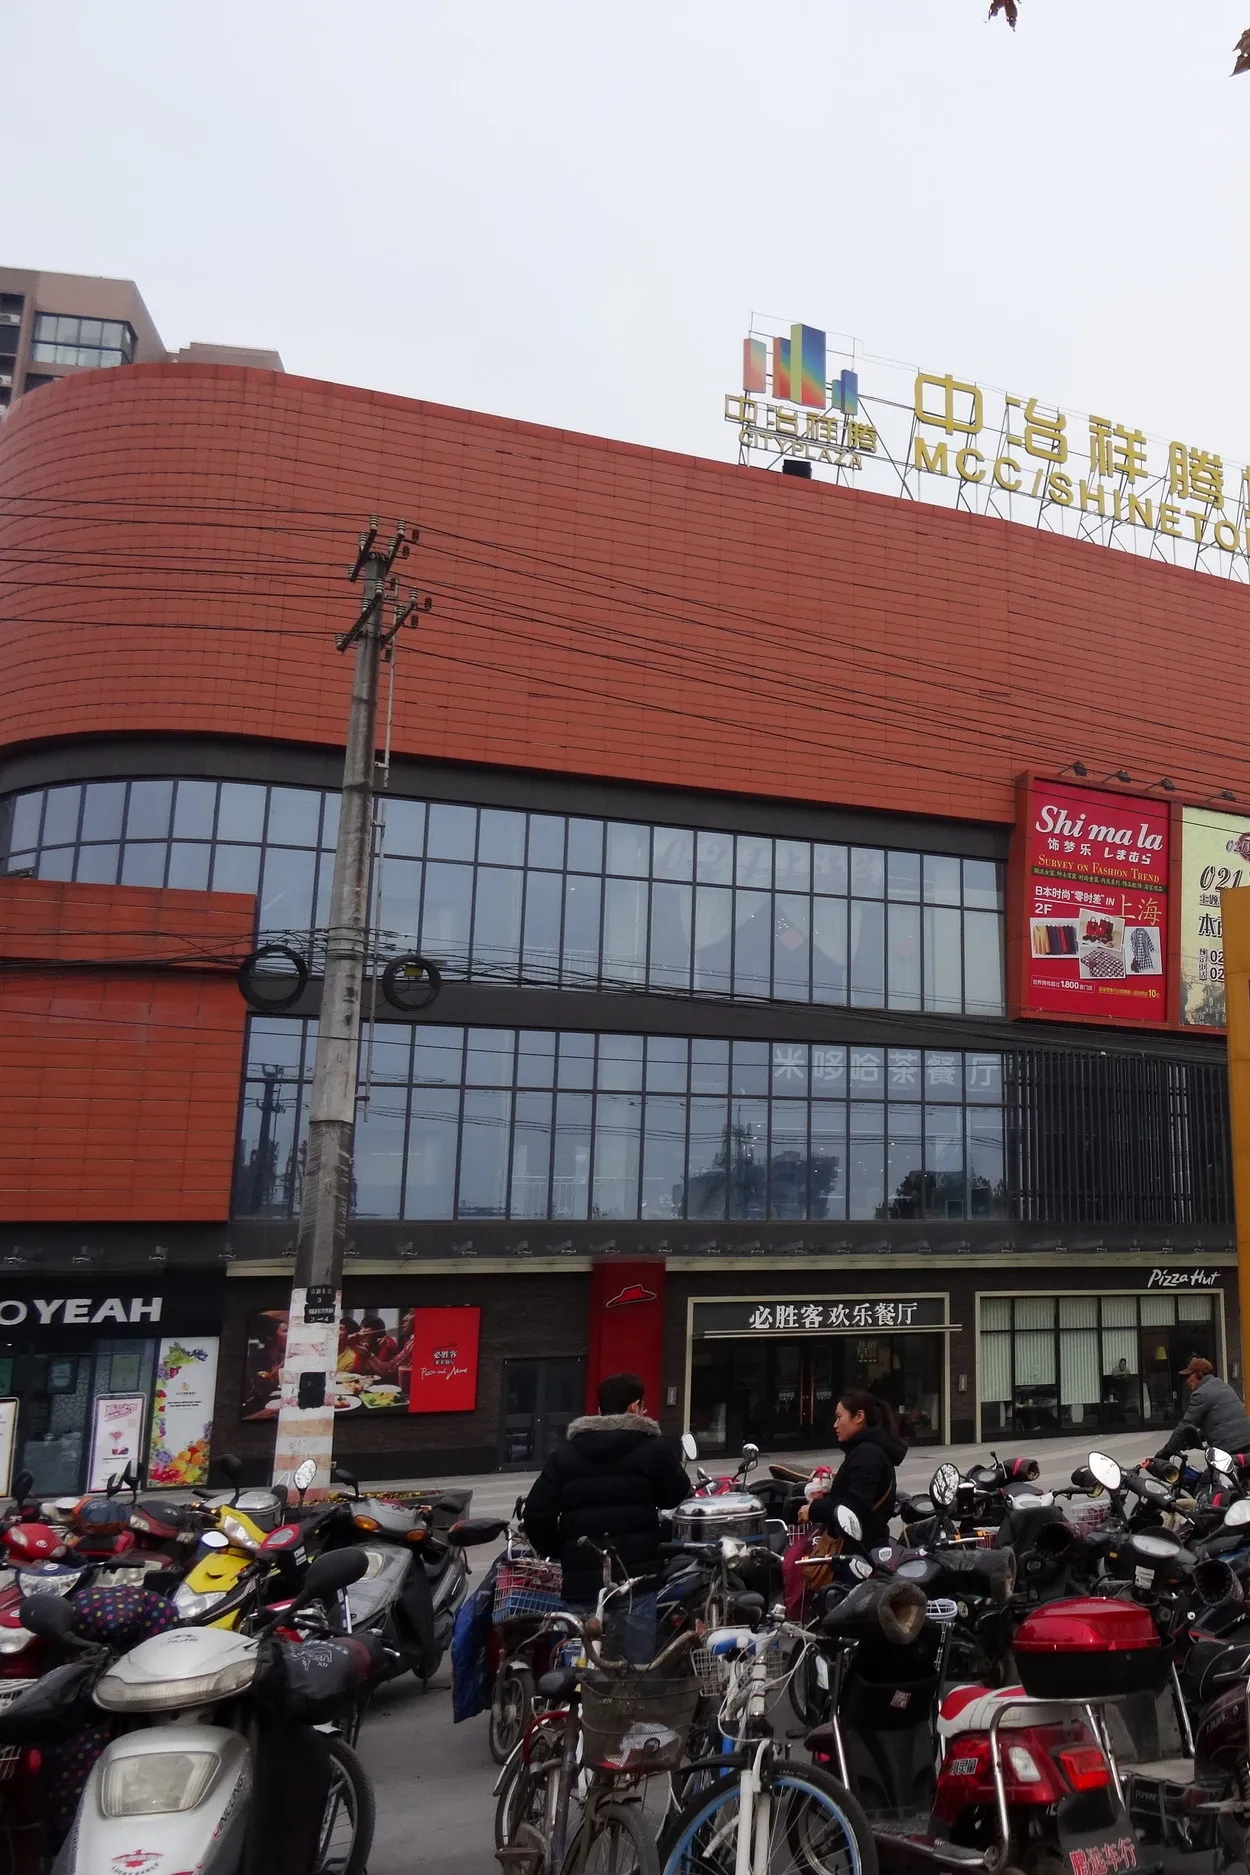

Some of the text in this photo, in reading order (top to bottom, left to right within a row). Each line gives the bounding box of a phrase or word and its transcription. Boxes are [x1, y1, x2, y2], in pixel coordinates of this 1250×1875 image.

[725, 394, 878, 453] 中冶祥腾
[1047, 837, 1152, 865] 饰梦乐 しまむら
[1035, 902, 1053, 915] 2F
[1105, 898, 1116, 907] IN
[1115, 893, 1163, 926] 上海
[773, 1047, 1000, 1087] 米哆哈茶餐厅
[1147, 1268, 1221, 1288] Pizza Hut
